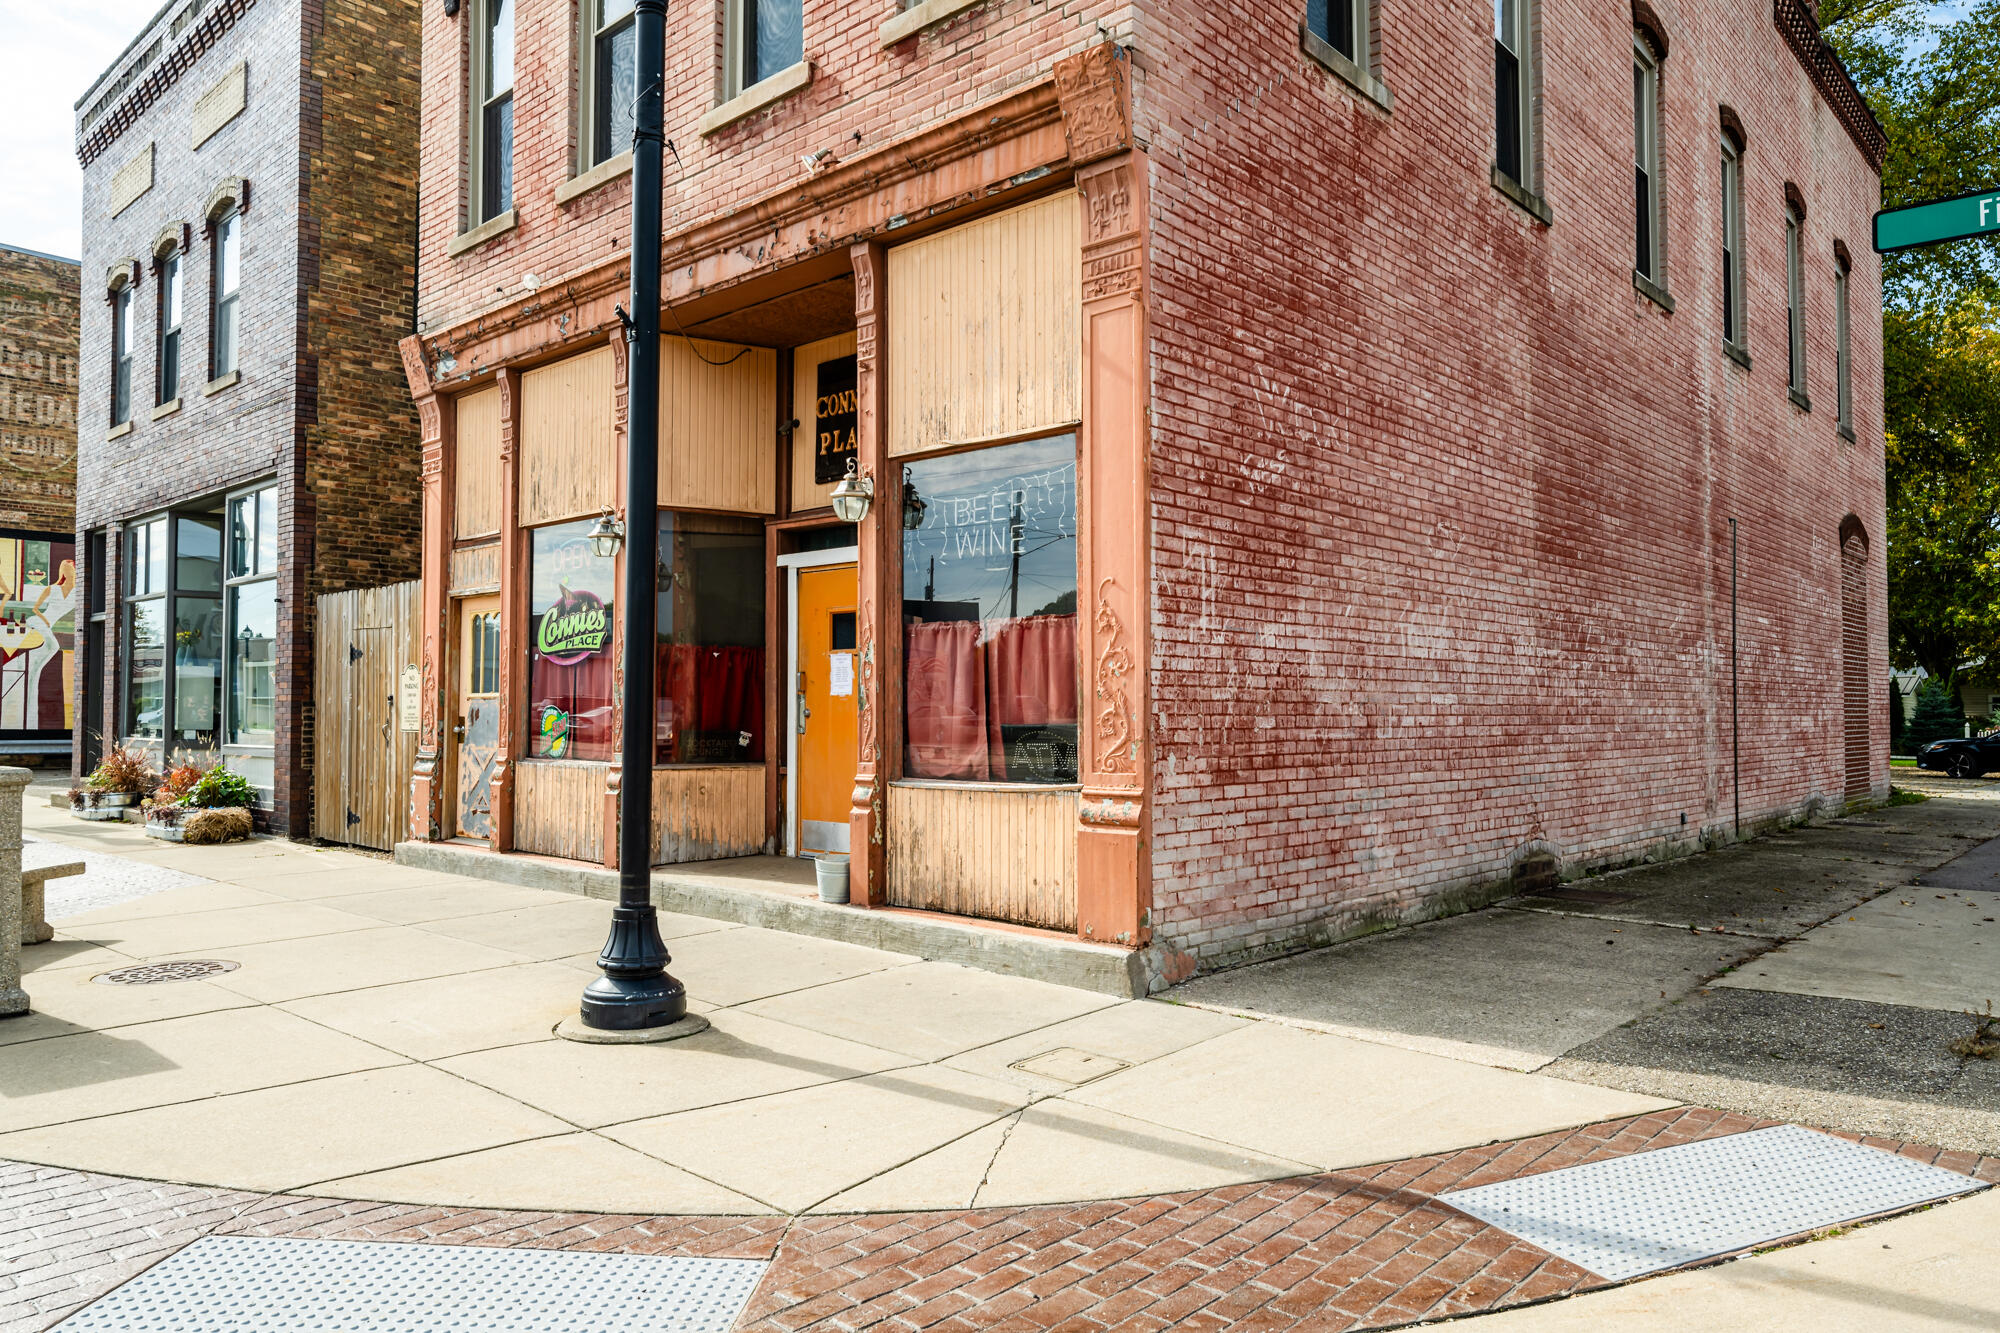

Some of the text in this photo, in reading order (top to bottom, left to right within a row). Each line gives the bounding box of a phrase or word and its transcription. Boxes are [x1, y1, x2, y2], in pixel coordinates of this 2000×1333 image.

[954, 489, 1028, 526] BEER
[955, 524, 1026, 559] WINE
[552, 544, 592, 571] OPEN
[538, 607, 606, 653] Connies
[564, 634, 599, 650] PLACE
[1011, 742, 1078, 770] ATM
